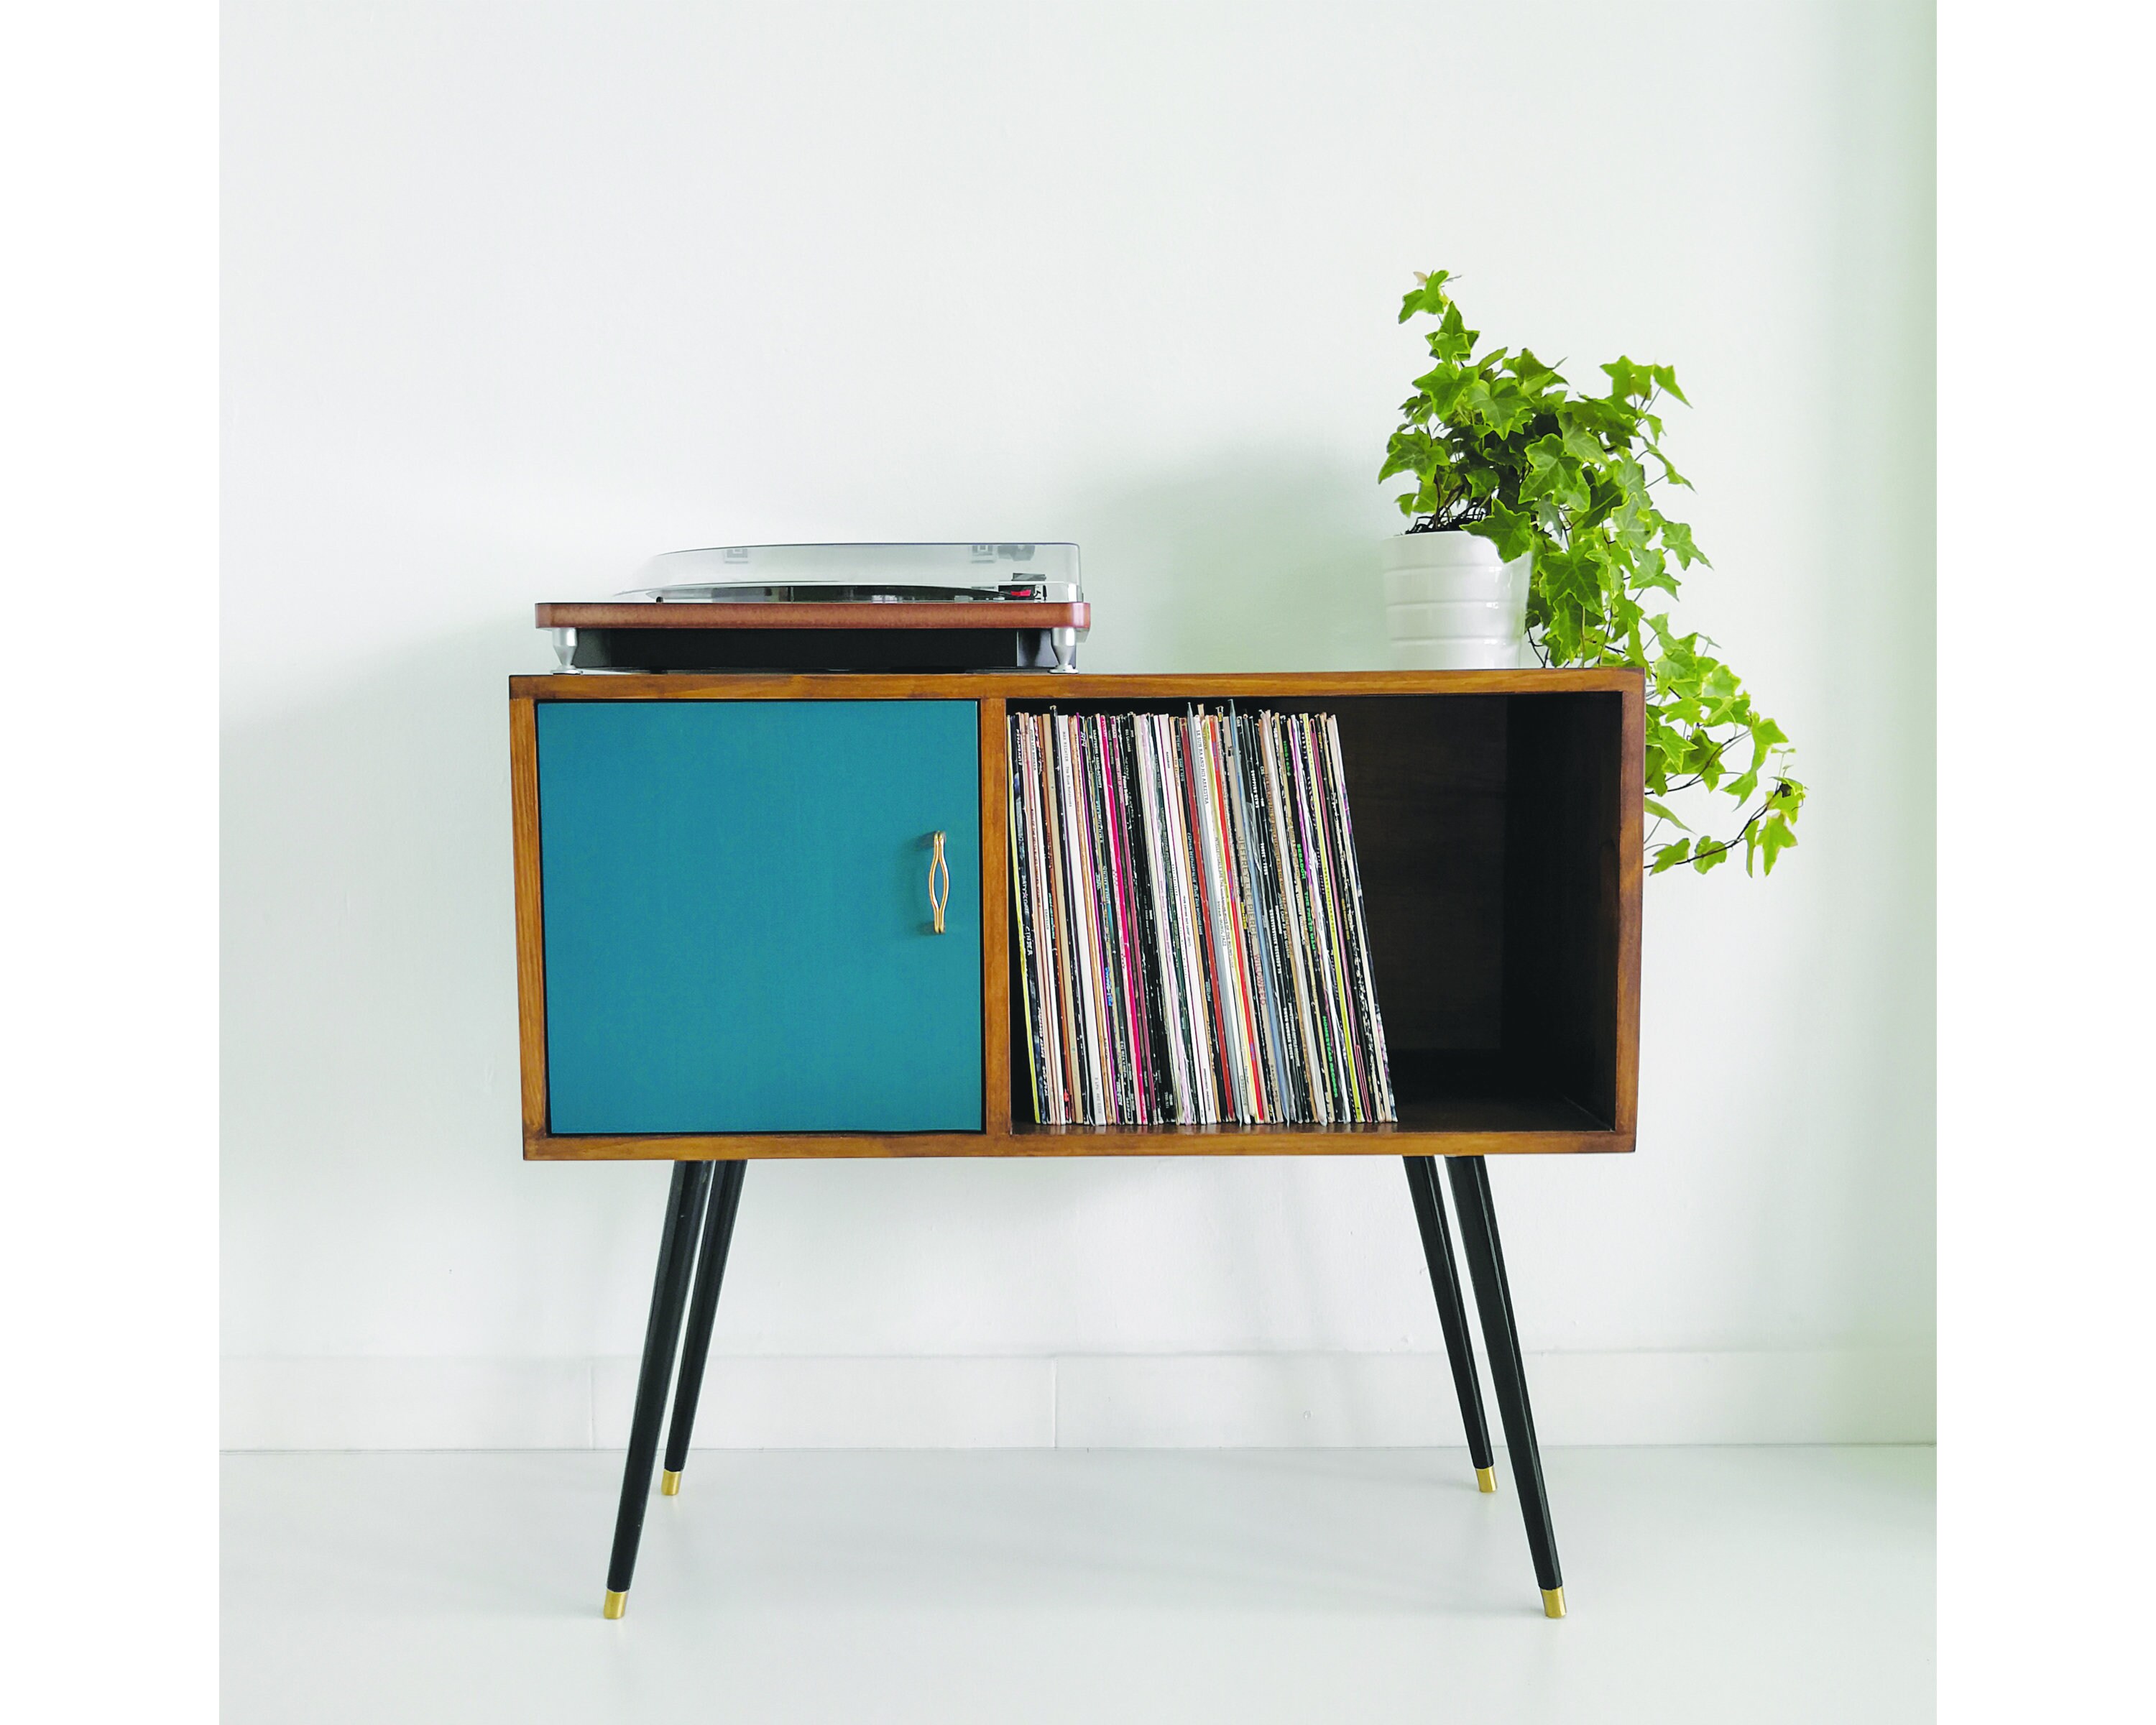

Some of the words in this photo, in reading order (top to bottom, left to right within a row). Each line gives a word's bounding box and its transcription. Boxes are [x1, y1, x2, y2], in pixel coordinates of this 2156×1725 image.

[1197, 748, 1204, 756] RA
[1201, 778, 1210, 805] ARKESTRA
[1237, 836, 1250, 878] JEFFREY
[1243, 881, 1253, 900] LEE
[1024, 925, 1033, 956] CINDER
[1245, 903, 1258, 939] PIERCE
[1253, 954, 1267, 1006] WILDWEED
[1322, 1015, 1333, 1062] HOMESTEAD
[1328, 1062, 1339, 1098] RECORDS
